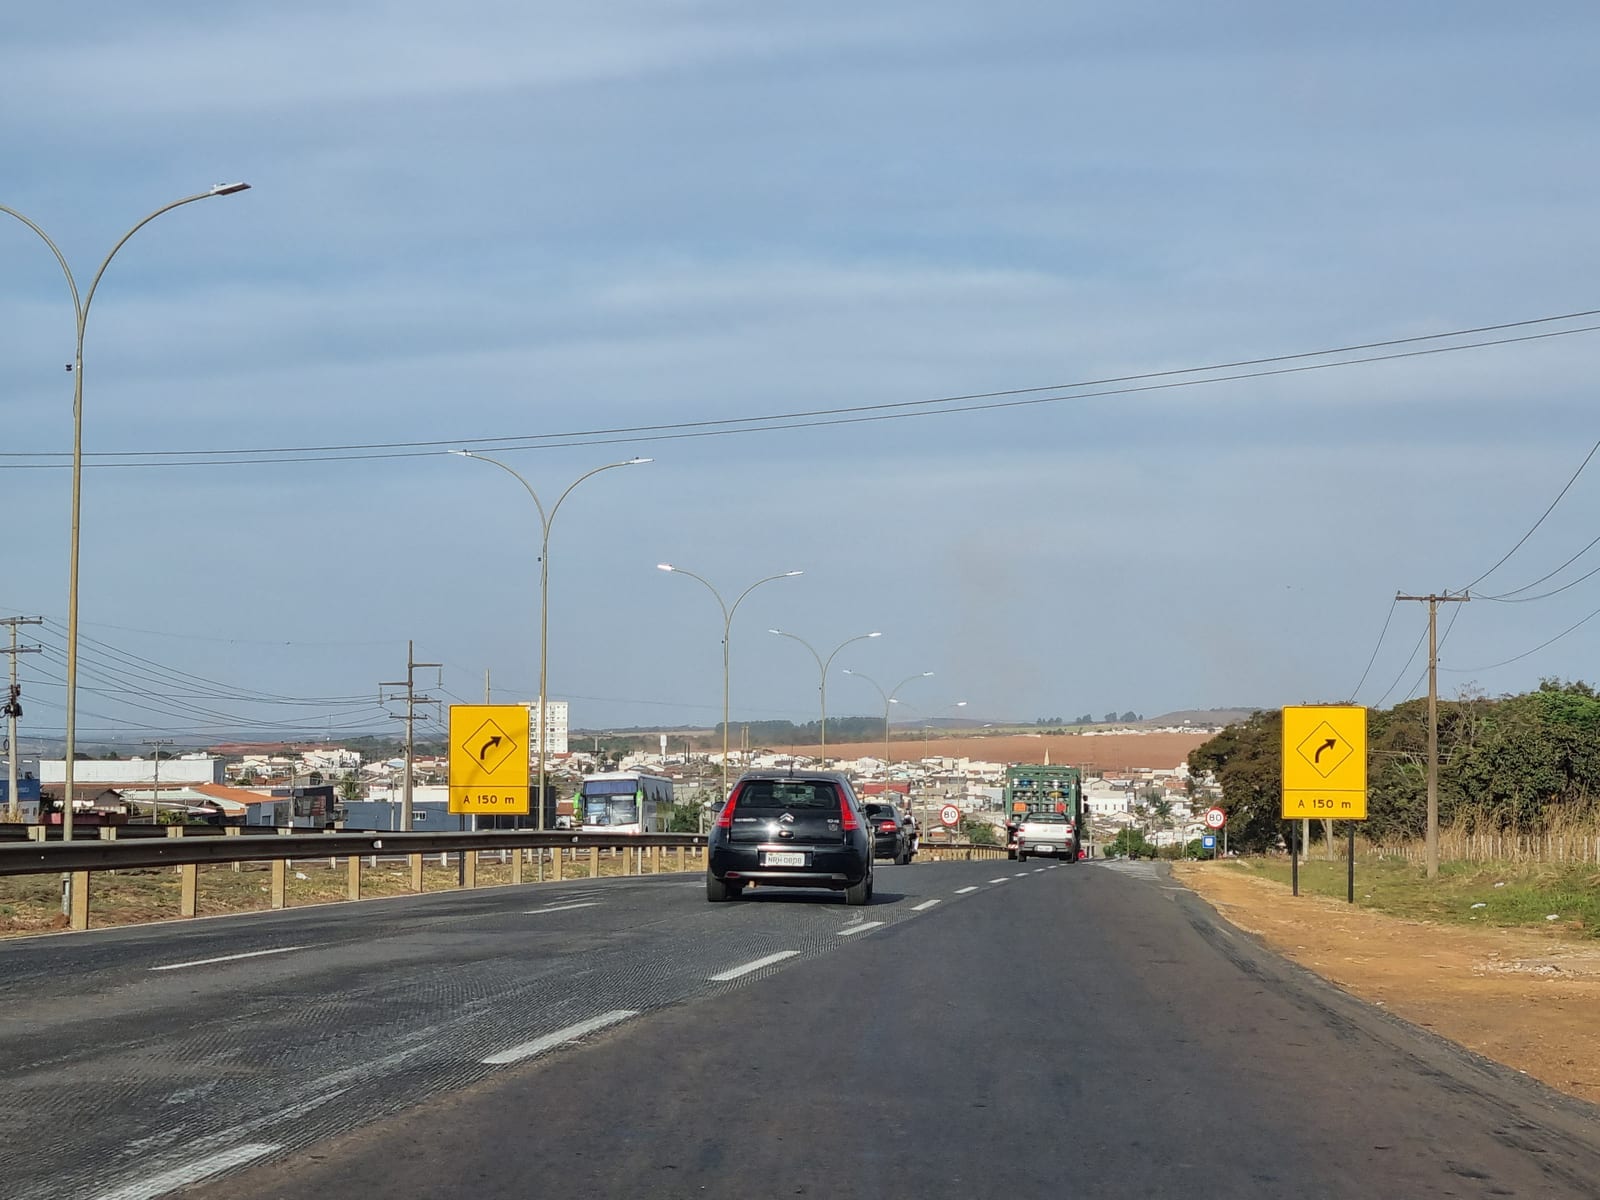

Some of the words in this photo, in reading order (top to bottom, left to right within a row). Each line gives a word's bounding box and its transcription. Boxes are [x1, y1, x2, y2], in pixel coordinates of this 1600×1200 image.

[463, 795, 471, 804] A
[477, 795, 498, 804] 150
[504, 796, 515, 804] m
[1297, 799, 1305, 808] A
[1312, 799, 1334, 809] 150
[1341, 801, 1352, 809] m
[943, 810, 957, 819] 80
[1209, 813, 1222, 821] 80
